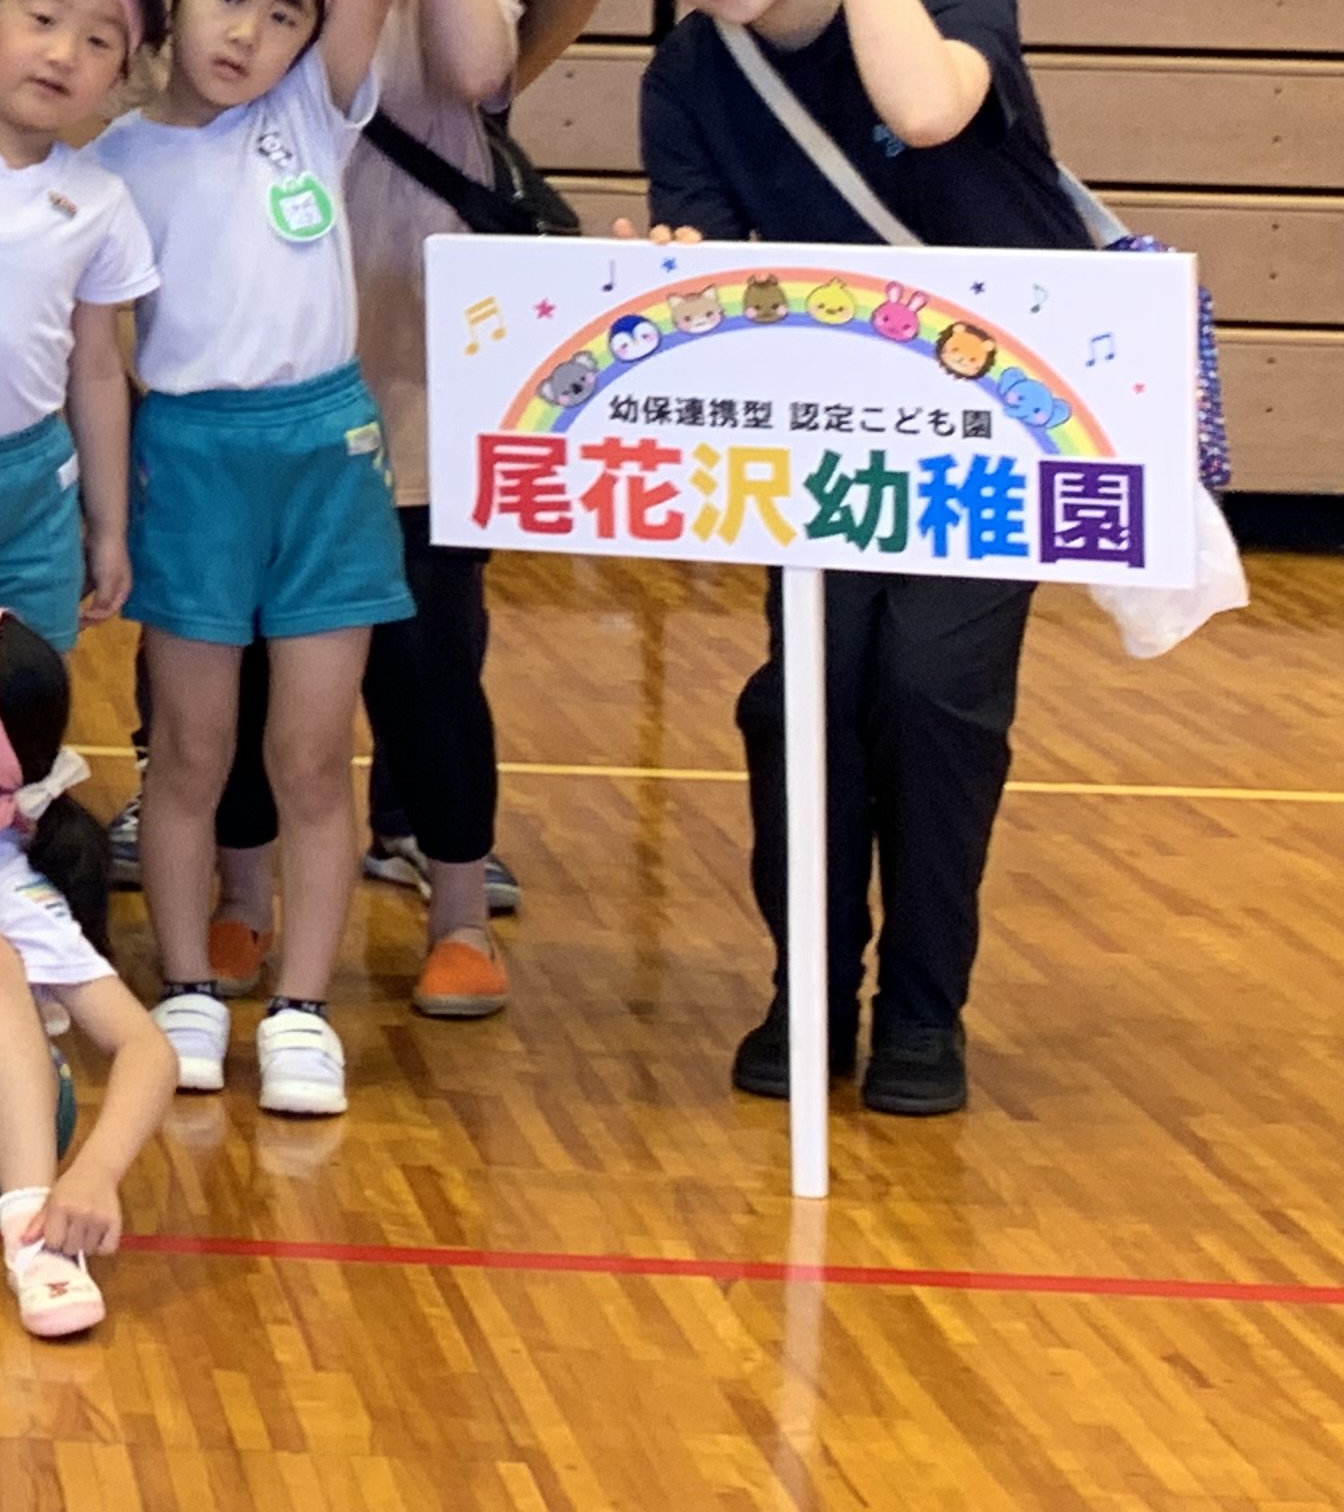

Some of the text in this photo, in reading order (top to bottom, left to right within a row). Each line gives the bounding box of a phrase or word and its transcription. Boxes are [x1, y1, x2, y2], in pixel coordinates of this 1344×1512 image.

[609, 394, 993, 439] 幼保連携型 認定こども園
[471, 432, 1147, 570] 尾花沢幼稚園
